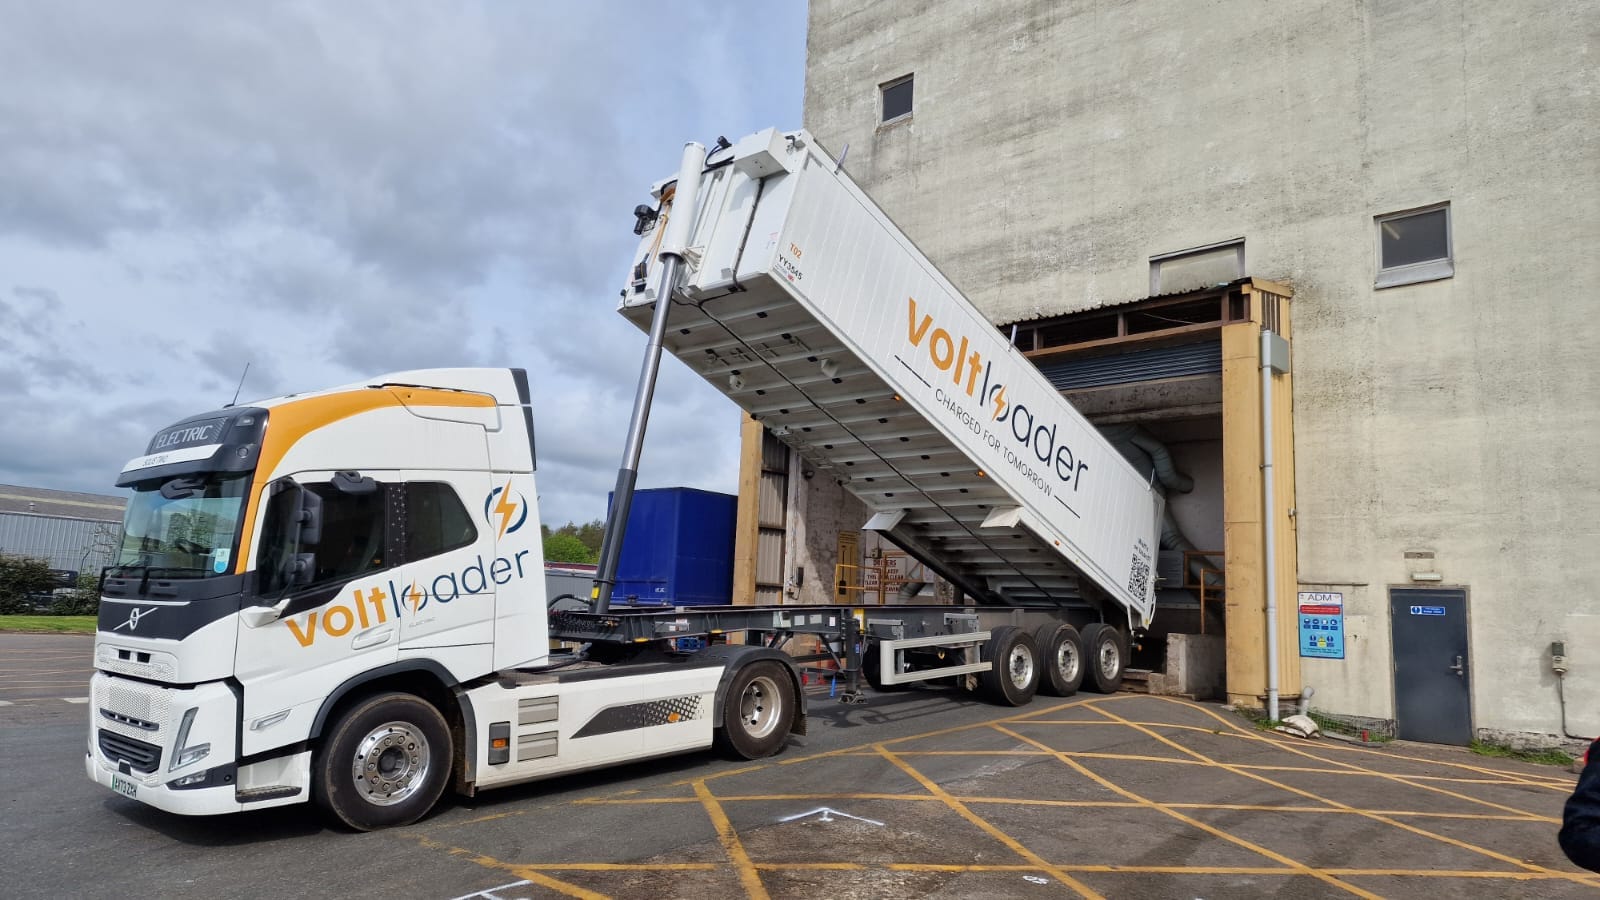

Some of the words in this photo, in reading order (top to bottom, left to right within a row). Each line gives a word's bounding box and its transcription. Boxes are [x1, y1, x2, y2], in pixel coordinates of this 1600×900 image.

[790, 242, 802, 259] T02
[779, 254, 803, 281] YY3545
[156, 425, 213, 449] ELECTRIC
[935, 387, 982, 435] CHARGED
[983, 430, 1001, 453] FOR
[1003, 446, 1053, 497] TOMORROW
[1307, 593, 1332, 602] ADM
